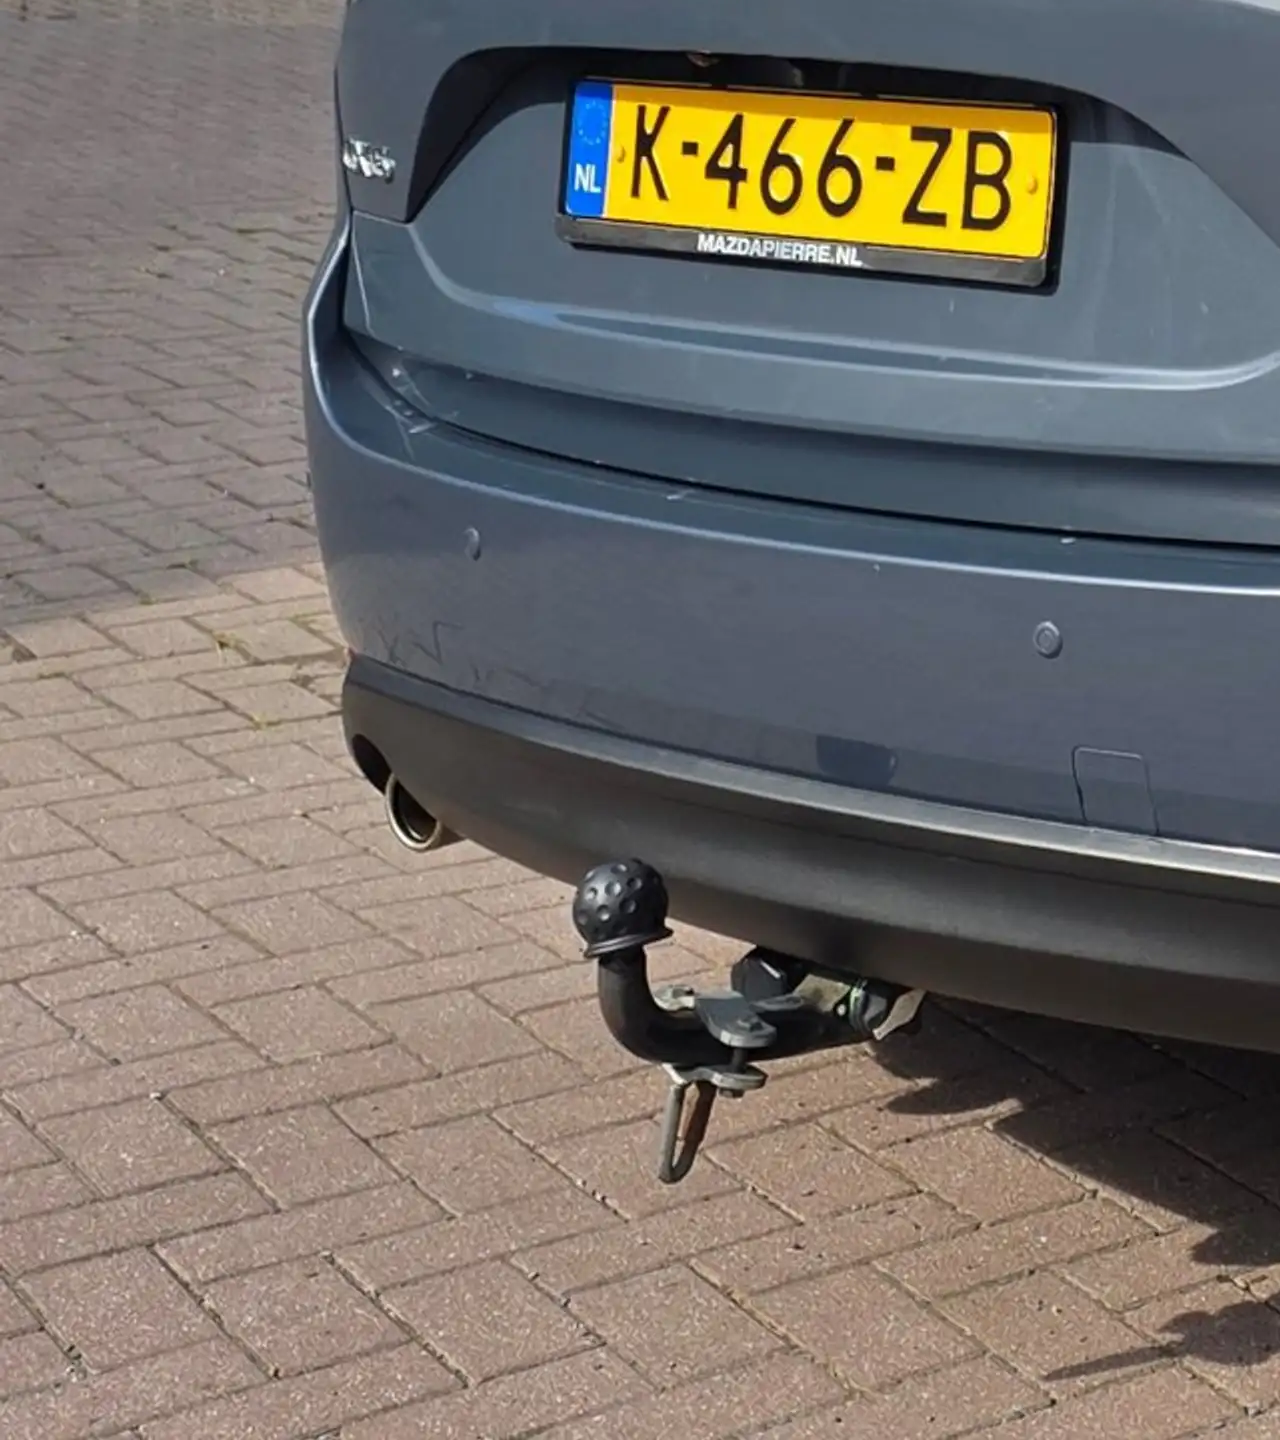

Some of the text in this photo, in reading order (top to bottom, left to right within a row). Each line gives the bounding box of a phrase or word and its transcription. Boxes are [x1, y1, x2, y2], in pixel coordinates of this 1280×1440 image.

[573, 162, 602, 193] NL
[630, 104, 1013, 232] K-466-ZB
[697, 232, 863, 267] MAZDAPIERRE.NL
